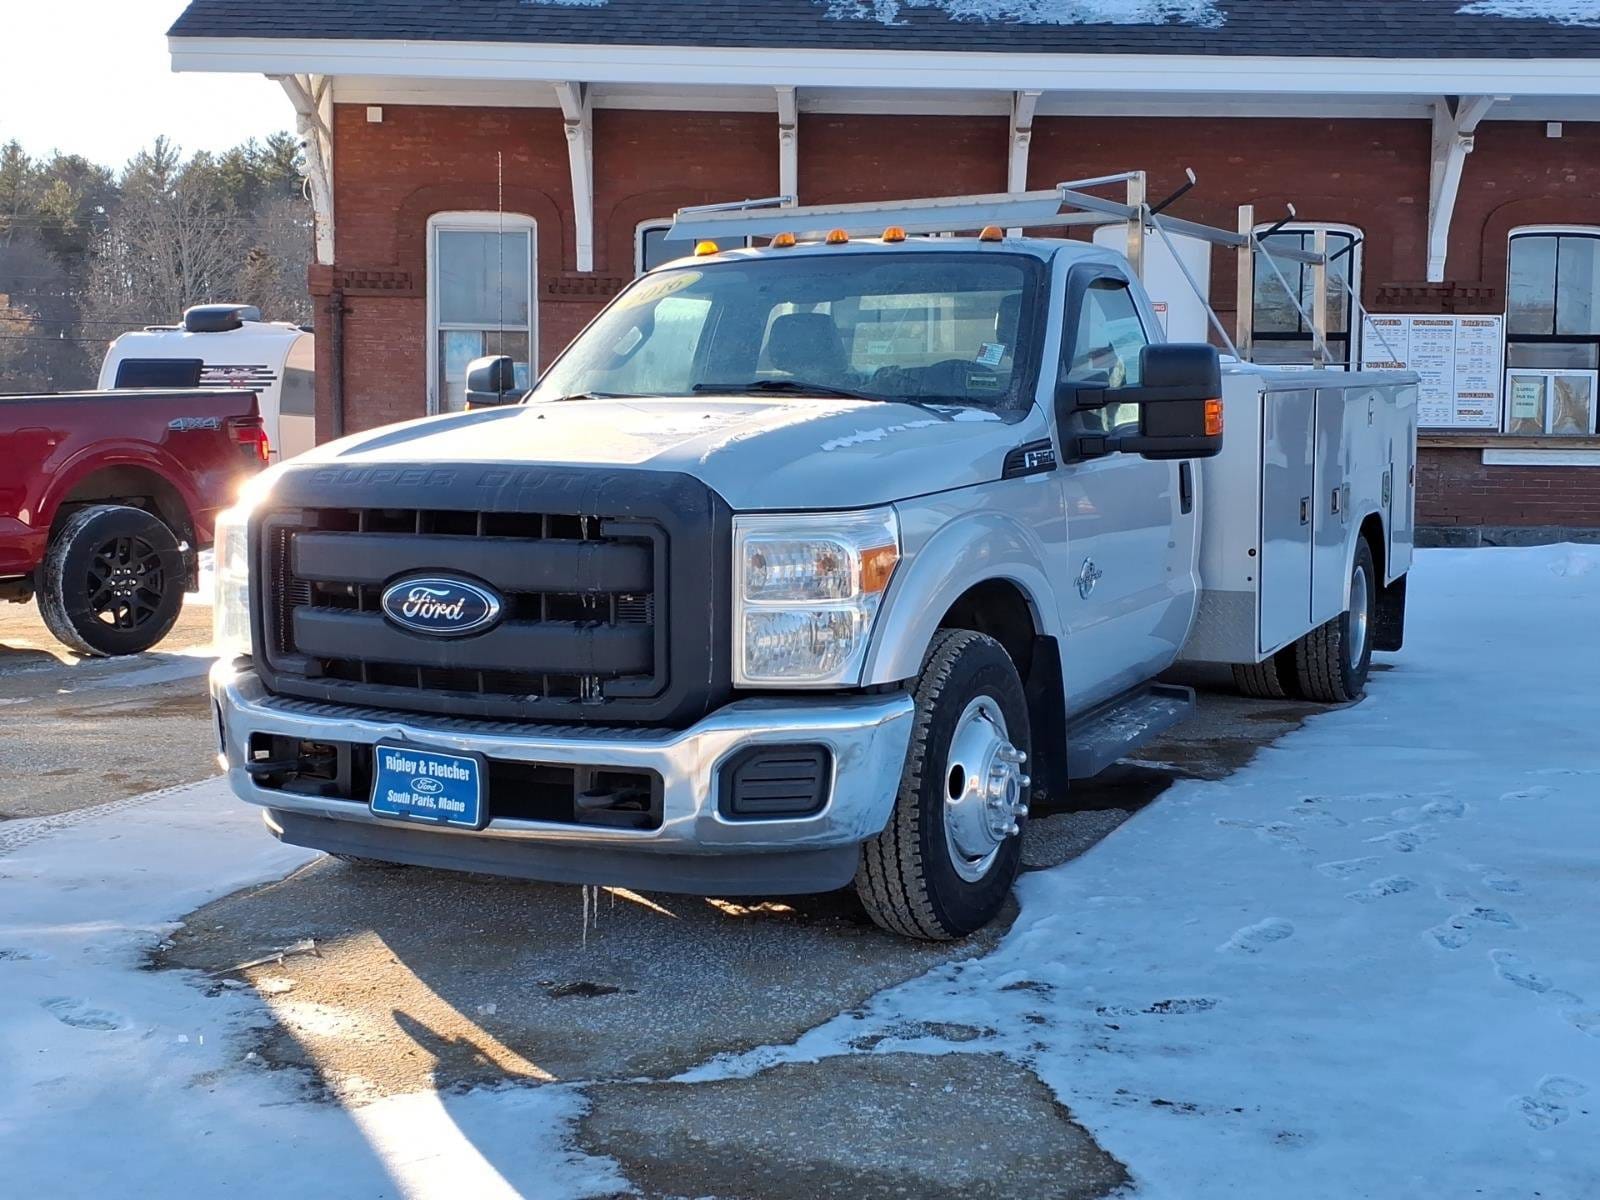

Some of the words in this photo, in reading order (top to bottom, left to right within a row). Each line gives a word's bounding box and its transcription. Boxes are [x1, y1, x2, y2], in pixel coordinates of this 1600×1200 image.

[310, 469, 458, 488] SUPER
[476, 469, 618, 492] DUTY
[402, 586, 466, 620] Ford
[386, 756, 416, 774] Ripley
[418, 761, 427, 774] &
[429, 762, 469, 780] Fletcher
[417, 779, 436, 791] Ford
[387, 789, 410, 804] South
[412, 794, 436, 809] Paris,
[438, 797, 465, 811] Maine
